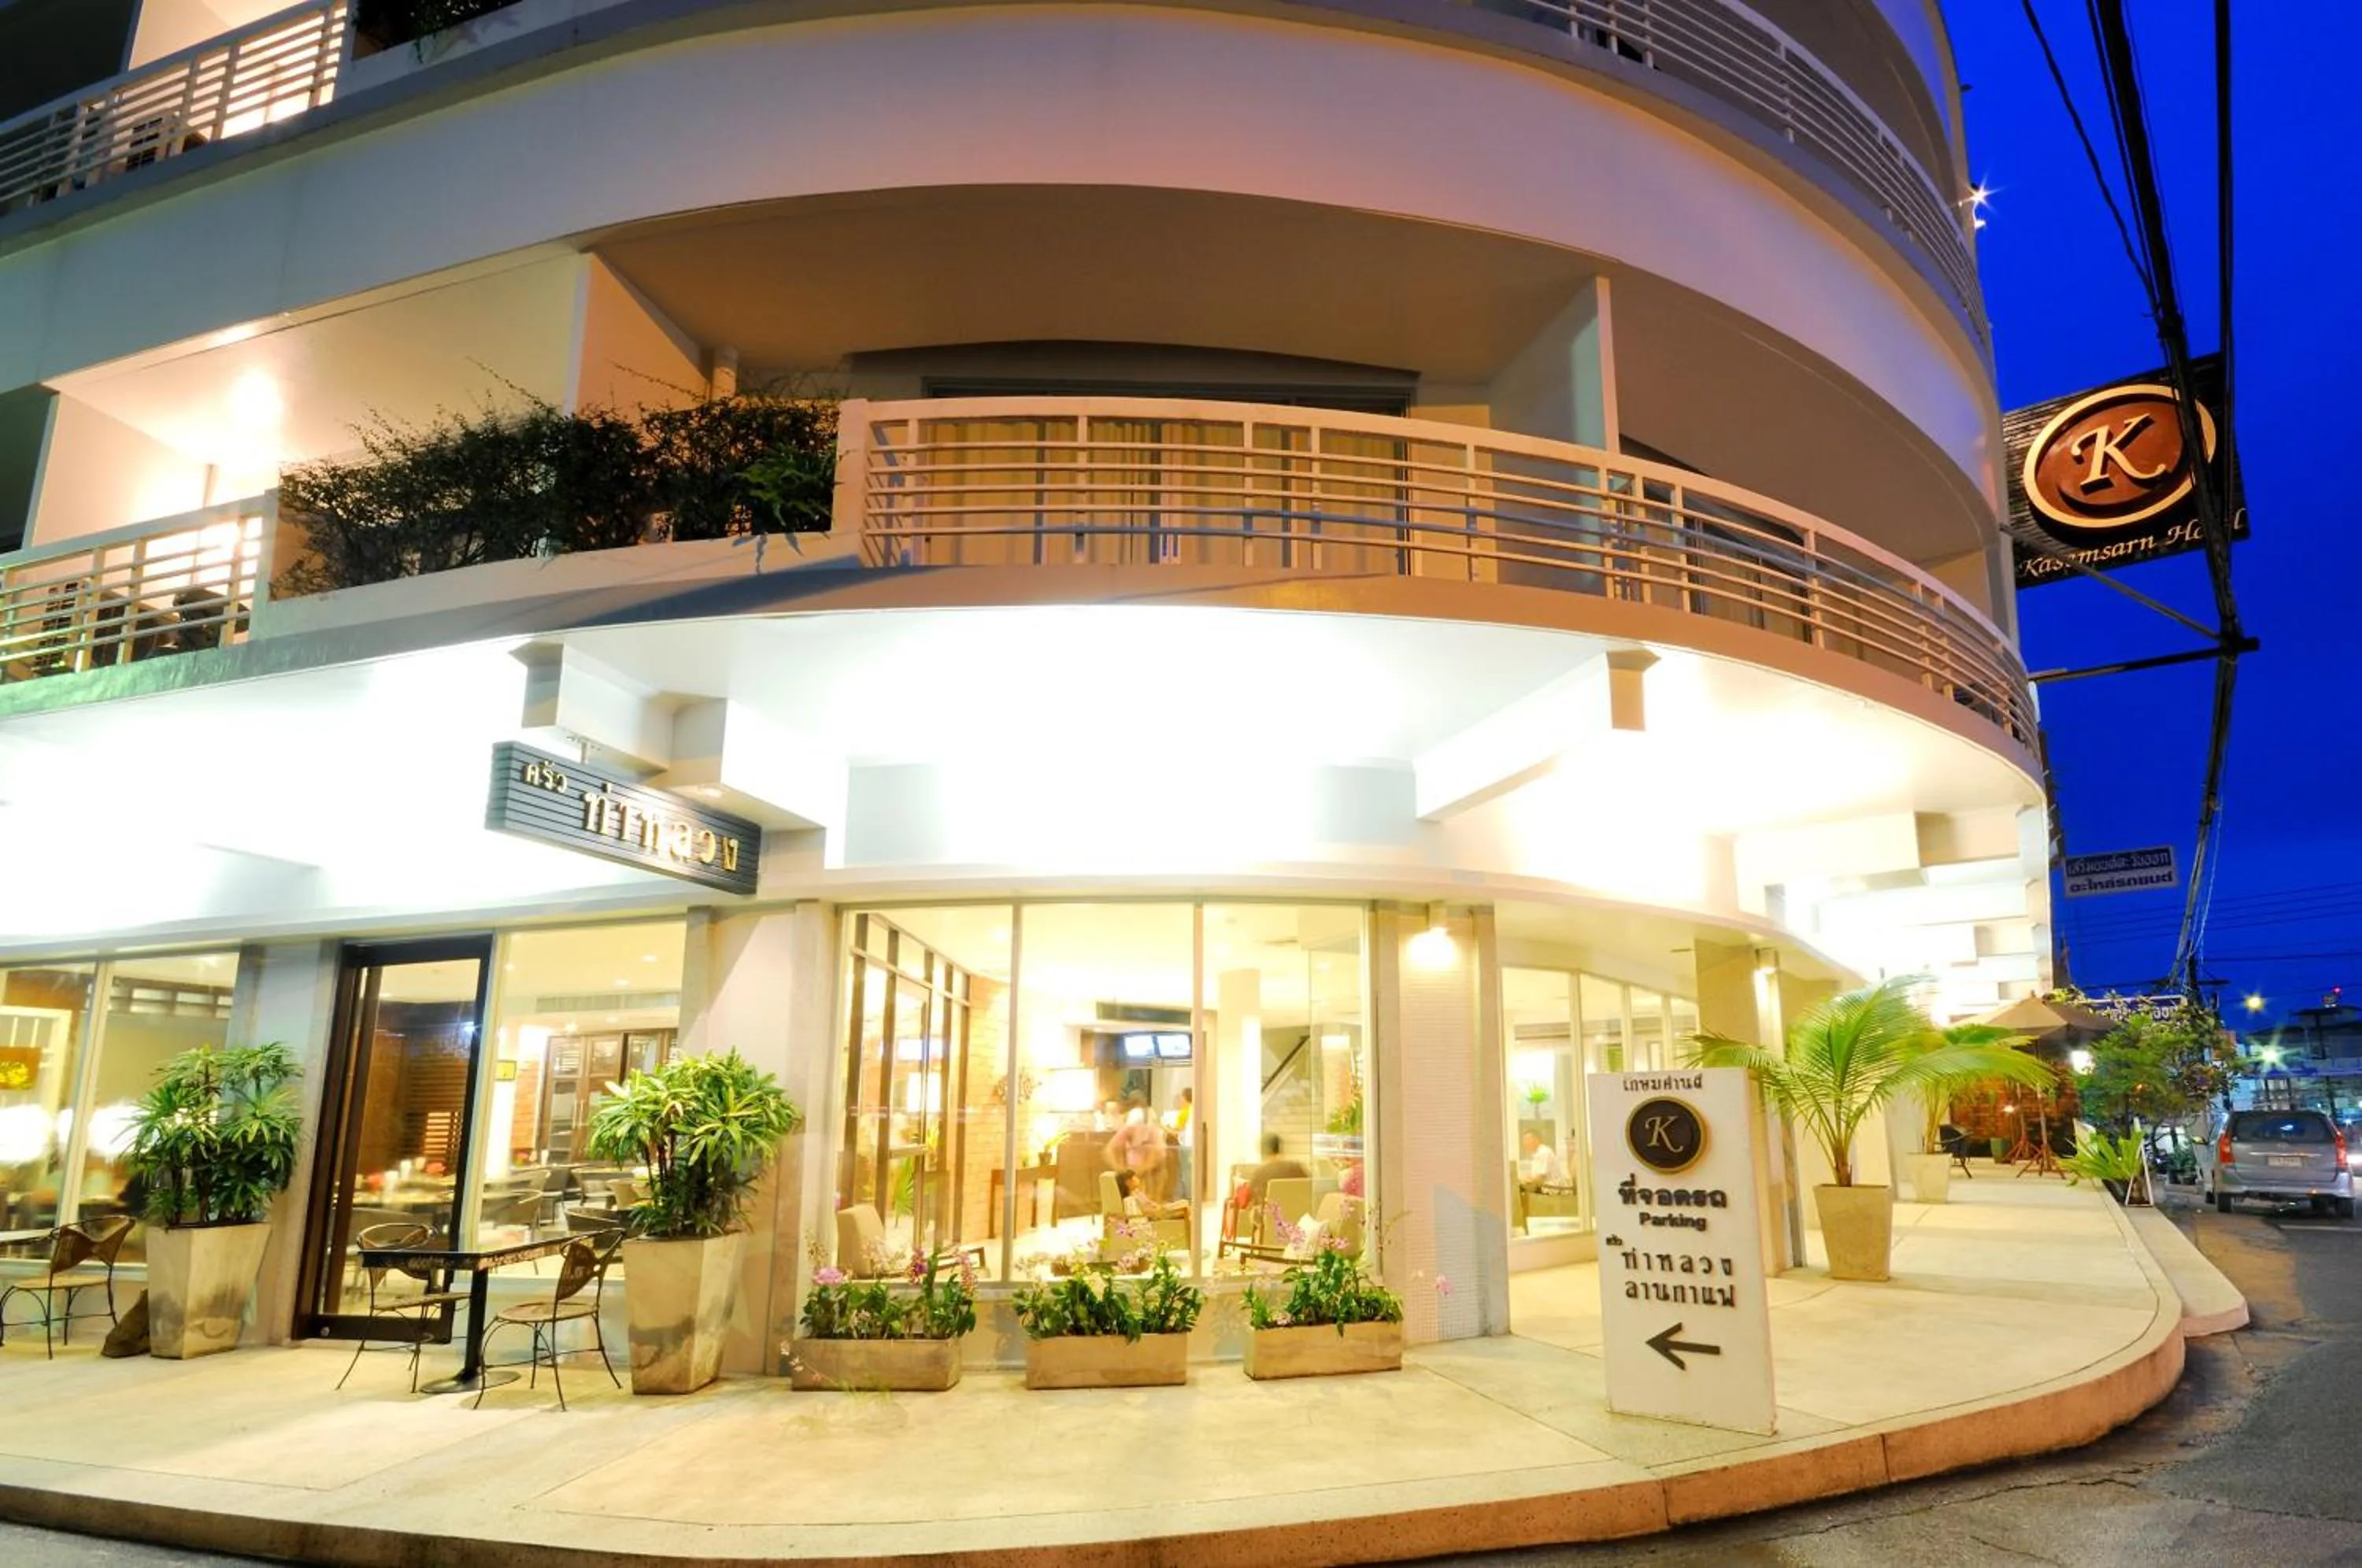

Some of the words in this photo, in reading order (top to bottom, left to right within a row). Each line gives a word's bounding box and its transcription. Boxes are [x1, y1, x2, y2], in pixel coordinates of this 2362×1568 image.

[2071, 413, 2166, 488] K
[2165, 508, 2245, 544] Hol
[524, 760, 568, 793] ครัว
[583, 782, 739, 871] ท่าหลวง
[2070, 871, 2173, 893] อะไหล่รถยนต์
[1645, 1115, 1684, 1153] K
[1618, 1172, 1727, 1208] ที่จอดรถ
[1638, 1211, 1707, 1232] Parking
[1621, 1247, 1734, 1276] ท่าหลวง
[1624, 1280, 1736, 1307] ลานกาแฟ
